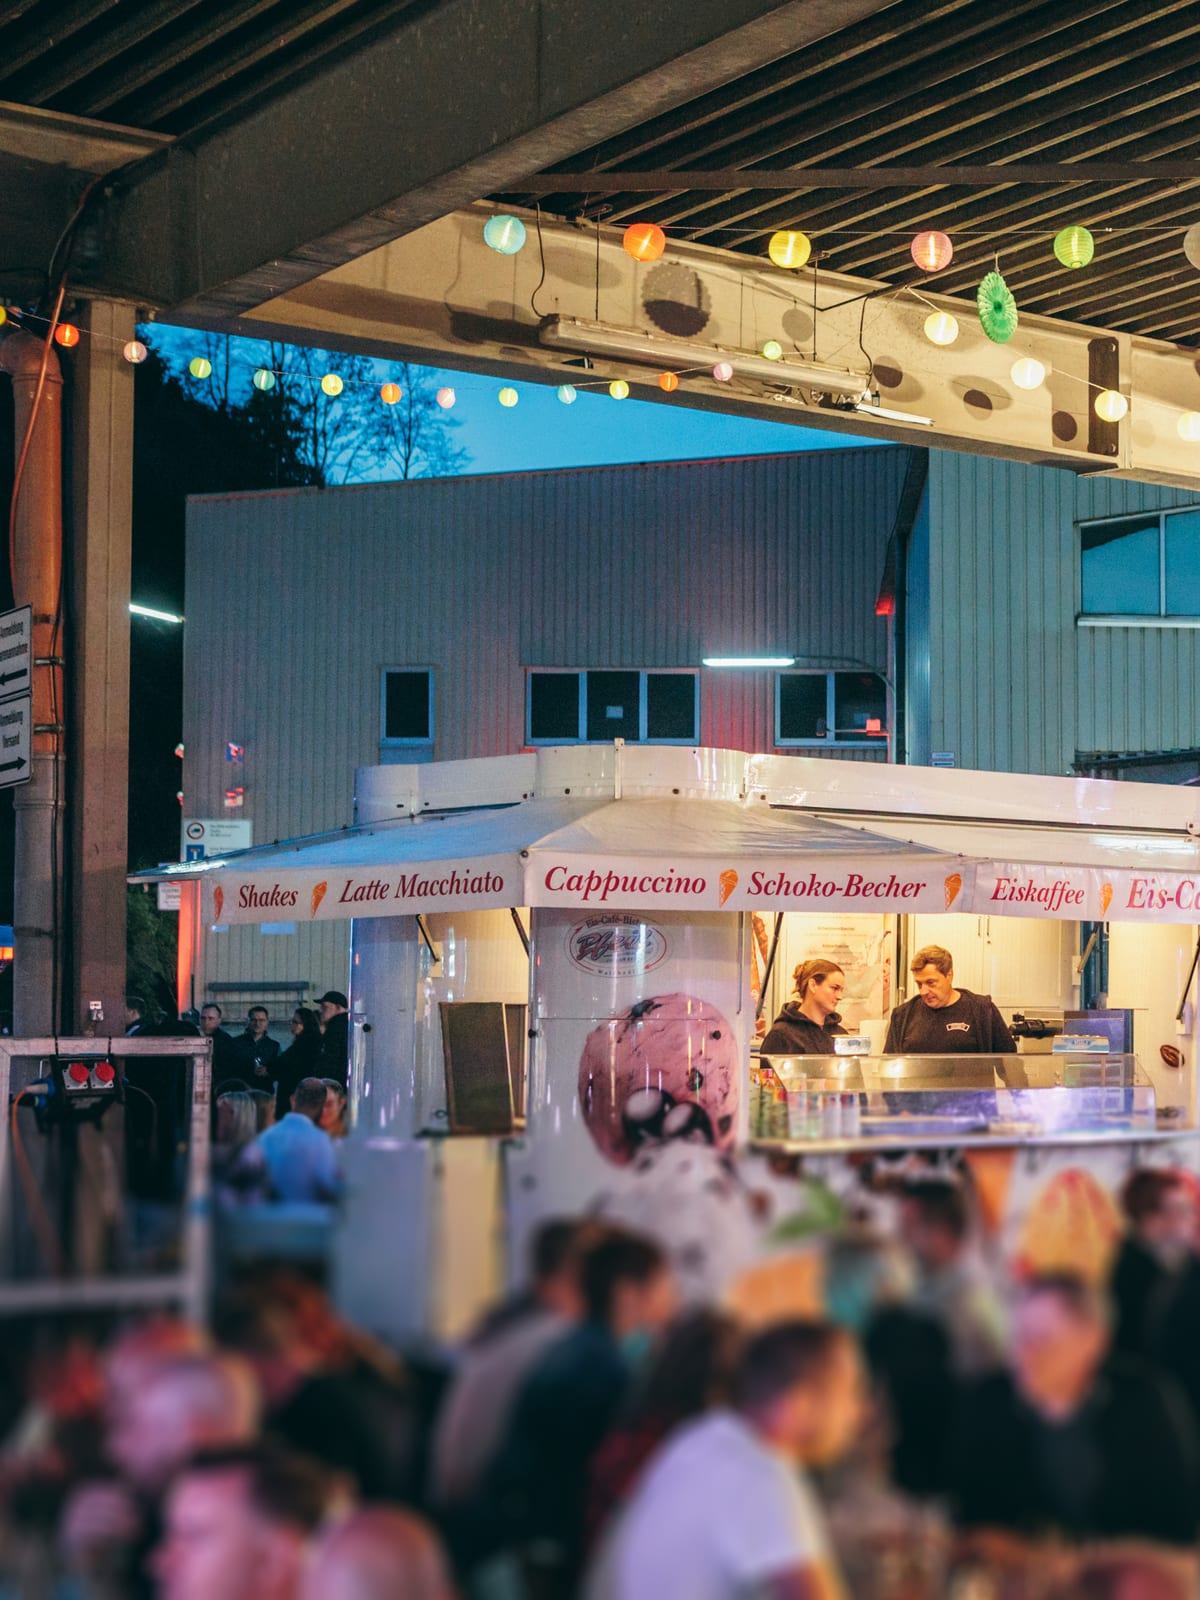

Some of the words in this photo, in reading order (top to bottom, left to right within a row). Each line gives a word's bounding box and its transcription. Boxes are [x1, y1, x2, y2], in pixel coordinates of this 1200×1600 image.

[239, 884, 299, 908] Shakes
[338, 879, 390, 903] Latte
[394, 869, 504, 899] Macchiato
[544, 866, 707, 901] Cappuccino
[747, 871, 926, 898] Schoko-Becher
[990, 878, 1084, 912] Eiskaffee
[586, 915, 642, 929] Eis-Café-Bist
